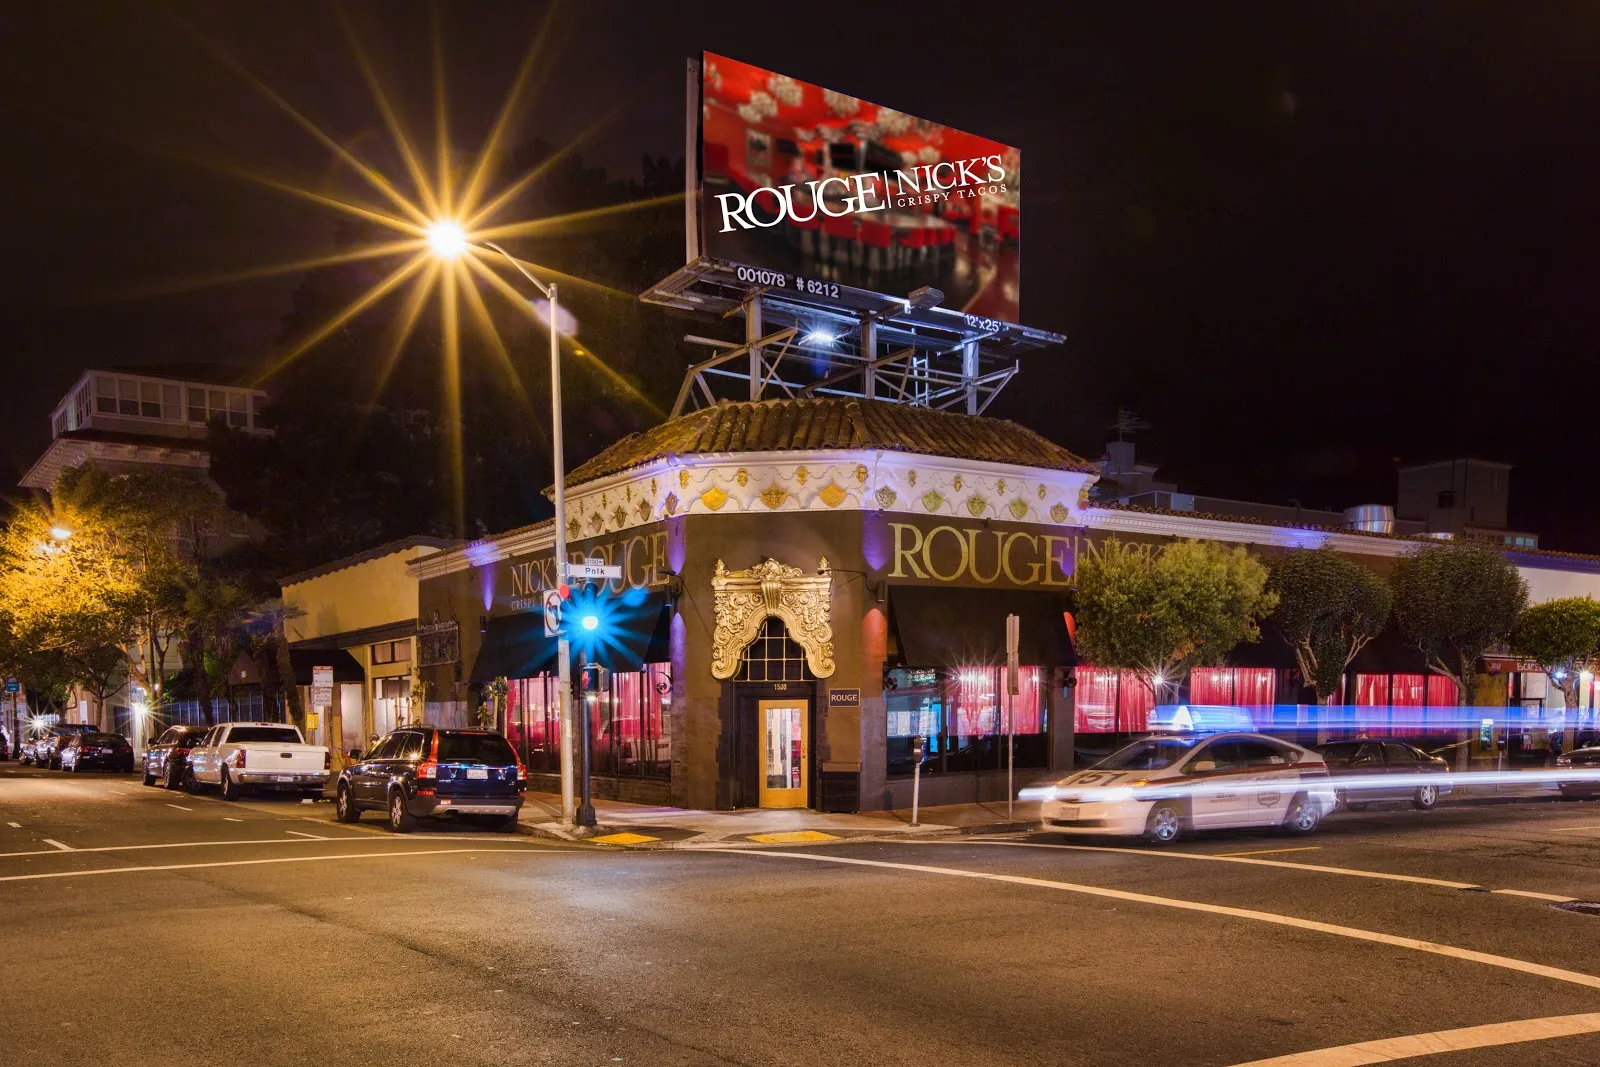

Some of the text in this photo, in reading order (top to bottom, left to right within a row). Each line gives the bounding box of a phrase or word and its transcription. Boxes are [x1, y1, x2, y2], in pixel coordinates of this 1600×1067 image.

[714, 154, 1006, 233] ROUGE NICK'S
[897, 184, 1007, 208] CRISPY TACOS
[737, 266, 786, 287] 001078
[807, 280, 839, 299] 6212
[888, 522, 1071, 586] ROUGE
[585, 567, 605, 575] Polk
[831, 694, 858, 702] ROUGE
